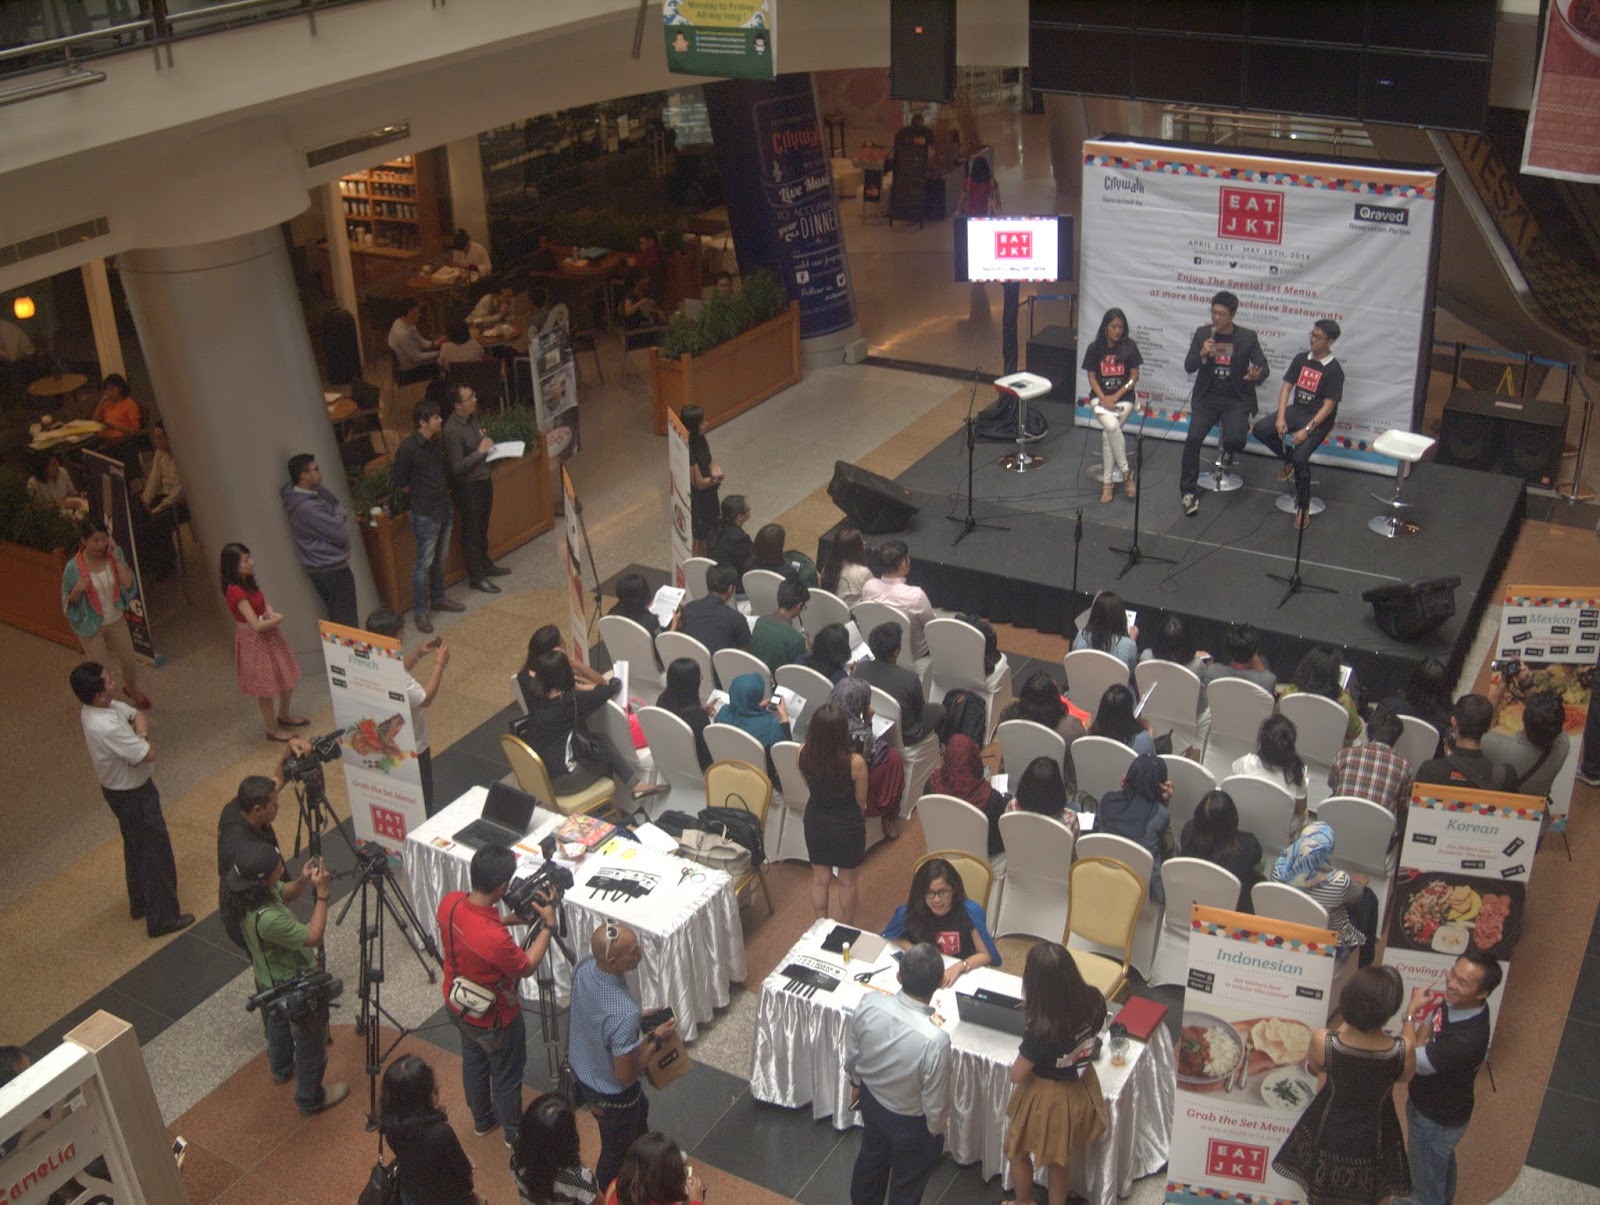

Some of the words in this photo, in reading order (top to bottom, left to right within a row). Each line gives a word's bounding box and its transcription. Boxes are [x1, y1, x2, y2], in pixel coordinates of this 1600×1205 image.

[688, 0, 719, 10] Monday
[729, 2, 754, 12] Friday
[1104, 176, 1146, 194] Citywalk
[1228, 194, 1276, 213] EAT
[1360, 206, 1404, 222] Qraved
[1226, 217, 1275, 235] JKT
[1388, 227, 1412, 236] Partner
[1000, 234, 1028, 243] EAT
[1000, 247, 1028, 256] JKT
[1188, 240, 1212, 250] APRIL
[1214, 242, 1234, 251] 21ST
[1242, 246, 1260, 254] MAY
[1290, 252, 1311, 260] 2014
[1176, 272, 1205, 286] Enjoy
[1207, 276, 1225, 286] The
[1227, 278, 1264, 292] Special
[1266, 284, 1281, 293] Set
[1283, 286, 1318, 298] Menus
[1150, 289, 1160, 297] at
[1162, 292, 1188, 300] more
[1189, 294, 1212, 304] than
[1238, 301, 1280, 313] xclusive
[1282, 305, 1344, 321] Restaurants
[1304, 370, 1318, 380] EAT
[1529, 614, 1577, 625] Mexican
[348, 654, 379, 671] French
[376, 810, 401, 825] EAT
[376, 823, 402, 838] JKT
[1446, 819, 1498, 835] Korean
[938, 936, 956, 944] AT
[1216, 948, 1304, 976] Indonesian
[1396, 963, 1438, 977] Craving
[1186, 1108, 1216, 1122] Grab
[1218, 1114, 1238, 1126] the
[1239, 1118, 1258, 1130] Set
[1217, 1145, 1262, 1161] EAT
[1214, 1161, 1259, 1176] JKT
